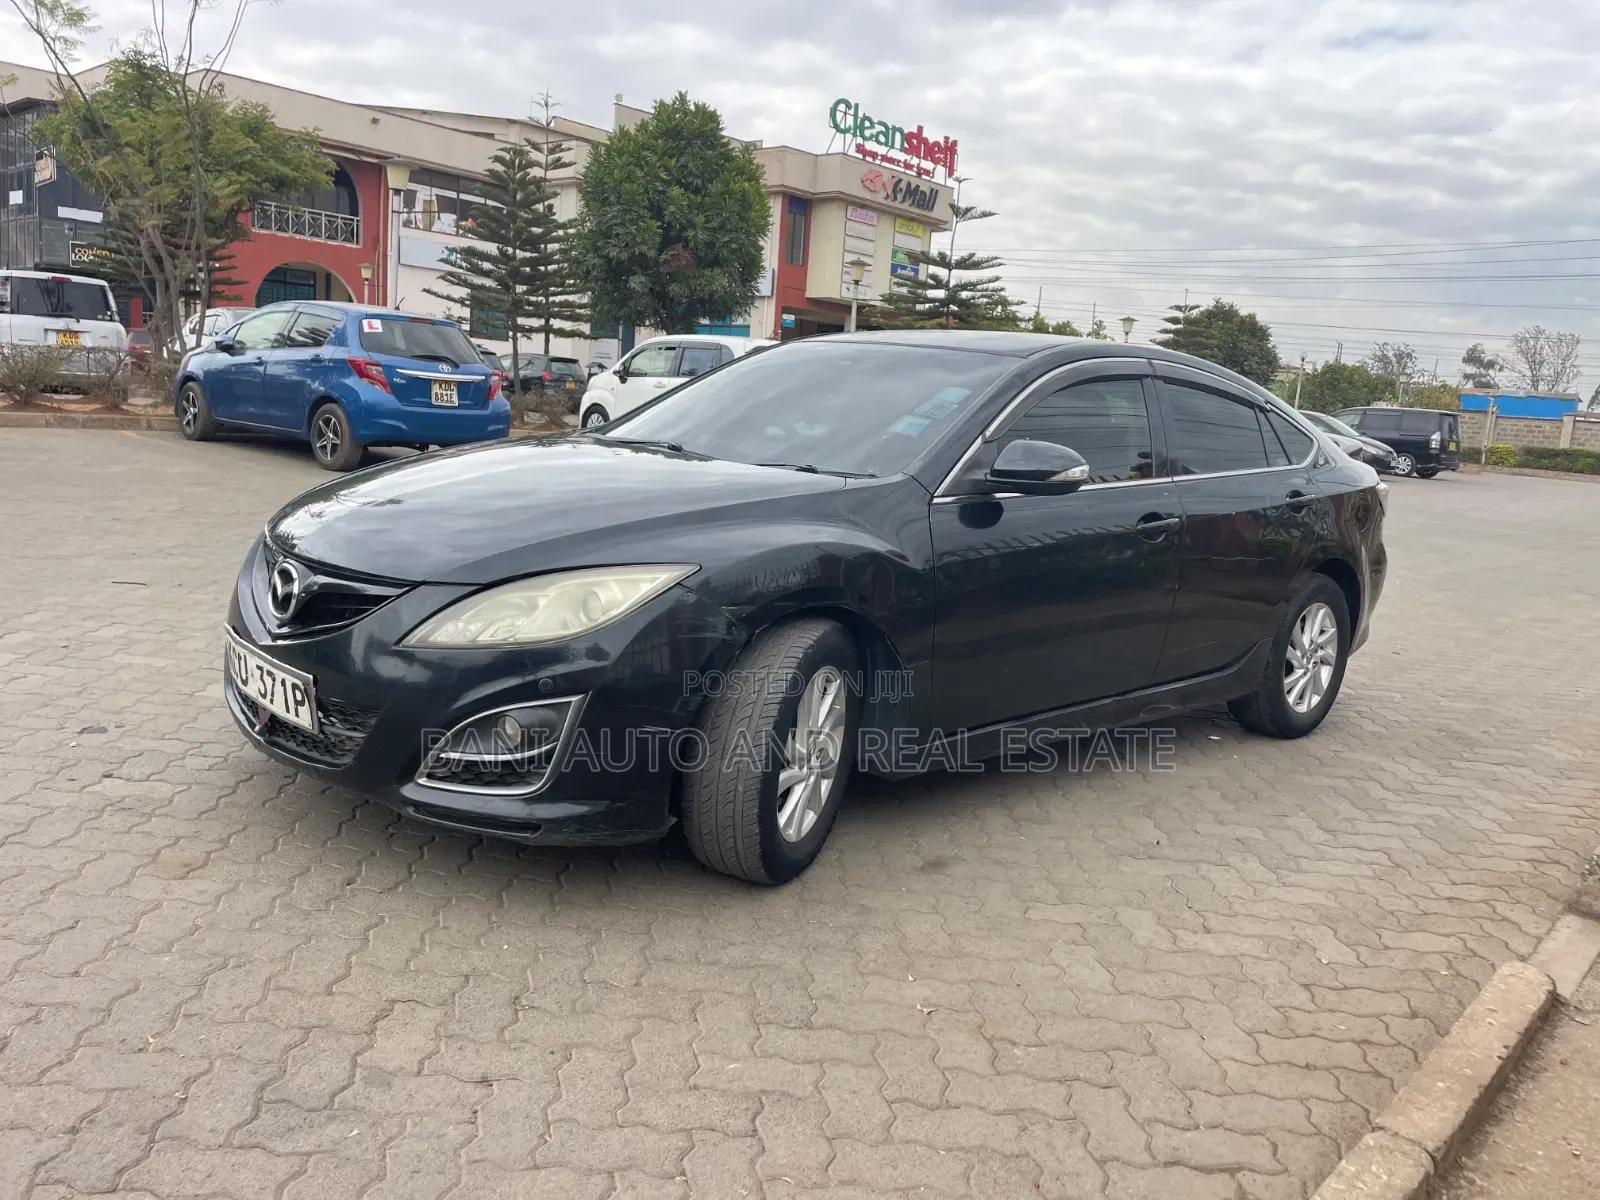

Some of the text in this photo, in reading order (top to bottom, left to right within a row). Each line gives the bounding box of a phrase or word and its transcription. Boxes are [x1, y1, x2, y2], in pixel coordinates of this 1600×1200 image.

[830, 97, 958, 179] Cleanshelf
[849, 206, 874, 223] Bata
[367, 320, 379, 330] L
[255, 663, 306, 719] 371P
